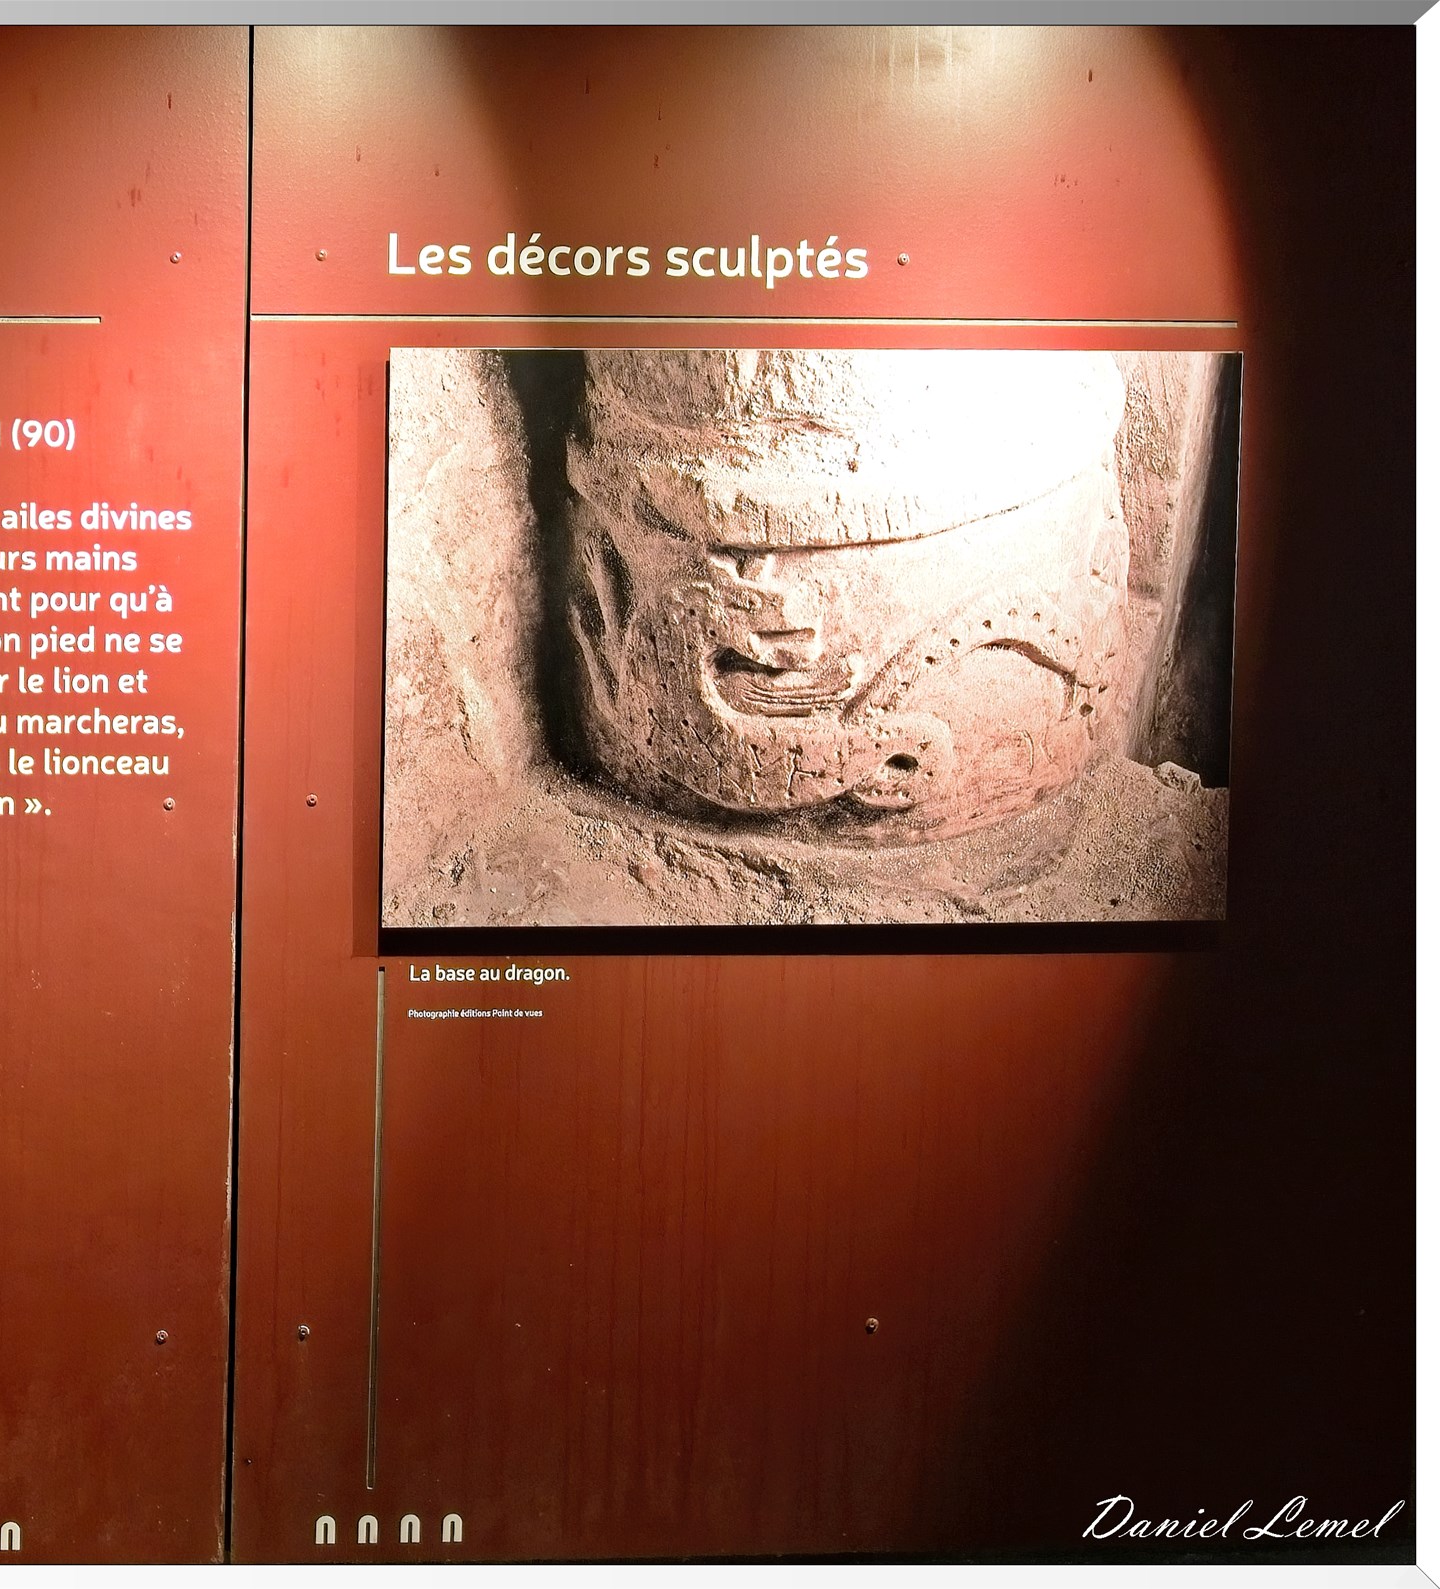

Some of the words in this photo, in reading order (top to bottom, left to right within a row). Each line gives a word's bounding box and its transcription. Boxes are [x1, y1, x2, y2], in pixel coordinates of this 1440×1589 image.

[388, 232, 472, 275] Les
[487, 232, 651, 277] décors
[666, 234, 872, 290] sculptés
[11, 418, 76, 451] (90)
[1, 501, 73, 531] ailes
[80, 501, 193, 531] divines
[45, 543, 138, 572] mains
[30, 591, 102, 619] pour
[30, 625, 95, 660] pied
[104, 632, 141, 654] ne
[149, 633, 183, 654] se
[18, 666, 45, 694] le
[53, 666, 109, 694] lion
[118, 669, 148, 694] et
[16, 707, 185, 739] marcheras,
[8, 747, 35, 775] le
[44, 747, 169, 776] lionceau
[24, 798, 52, 816] ».
[409, 964, 431, 982] La
[435, 964, 476, 982] base
[479, 968, 501, 981] au
[504, 963, 570, 986] dragon.
